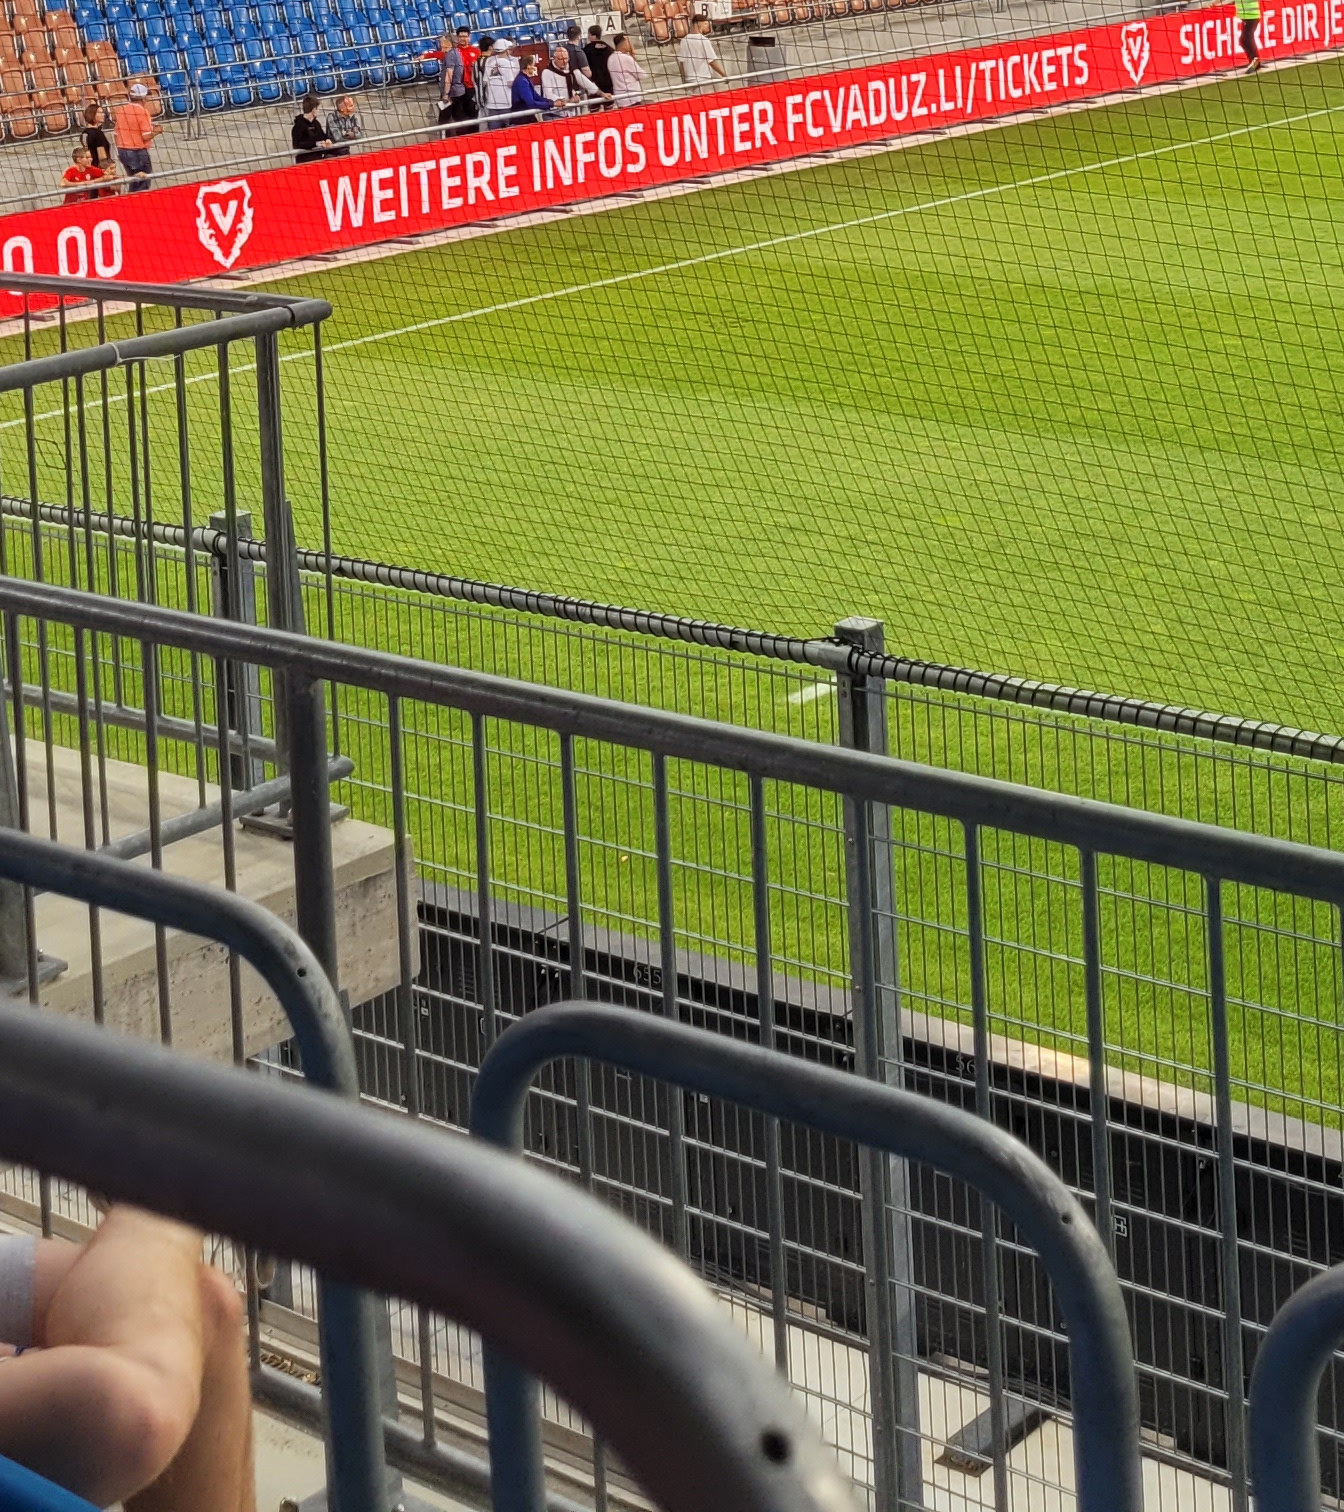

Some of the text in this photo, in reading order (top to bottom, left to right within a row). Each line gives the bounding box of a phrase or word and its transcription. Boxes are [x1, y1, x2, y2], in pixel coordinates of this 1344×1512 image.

[605, 15, 617, 32] A
[701, 3, 709, 17] B
[1281, 1, 1319, 45] DIR
[319, 42, 1090, 233] WEITERE INFOS UNTER FCVADUZ.LI/TICKETS
